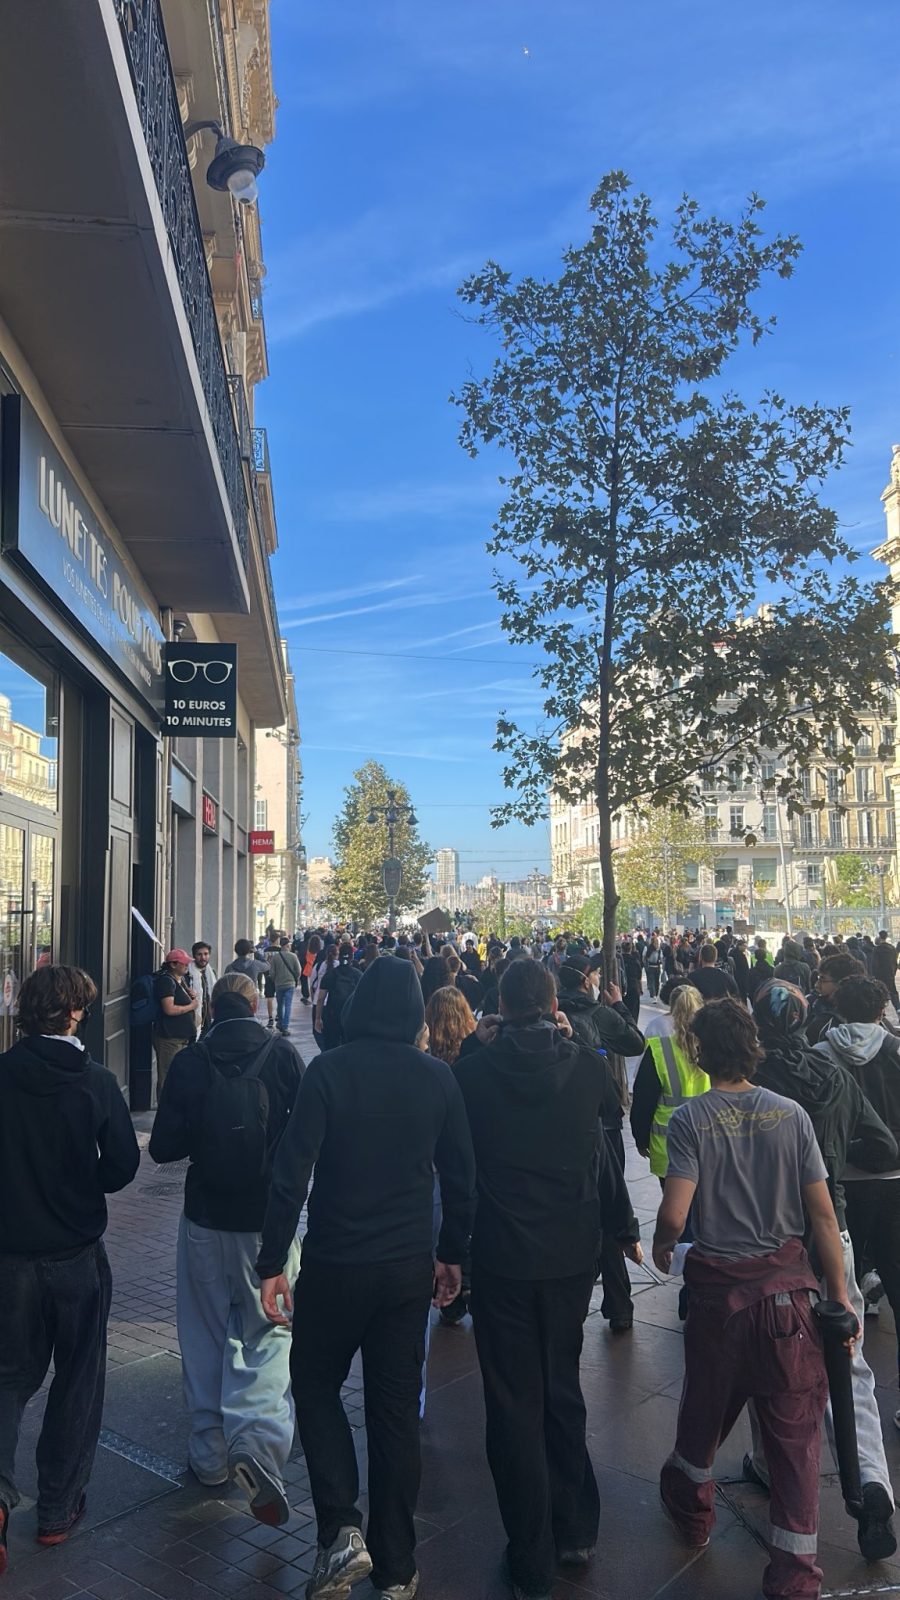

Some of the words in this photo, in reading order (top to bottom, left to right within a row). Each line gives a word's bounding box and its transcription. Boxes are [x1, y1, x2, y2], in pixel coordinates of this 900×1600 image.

[38, 456, 108, 600] LUNETTES
[173, 699, 186, 709] 10
[188, 700, 226, 710] EUROS
[166, 715, 180, 726] 10
[182, 716, 232, 727] MINUTES
[252, 838, 274, 846] HEMA
